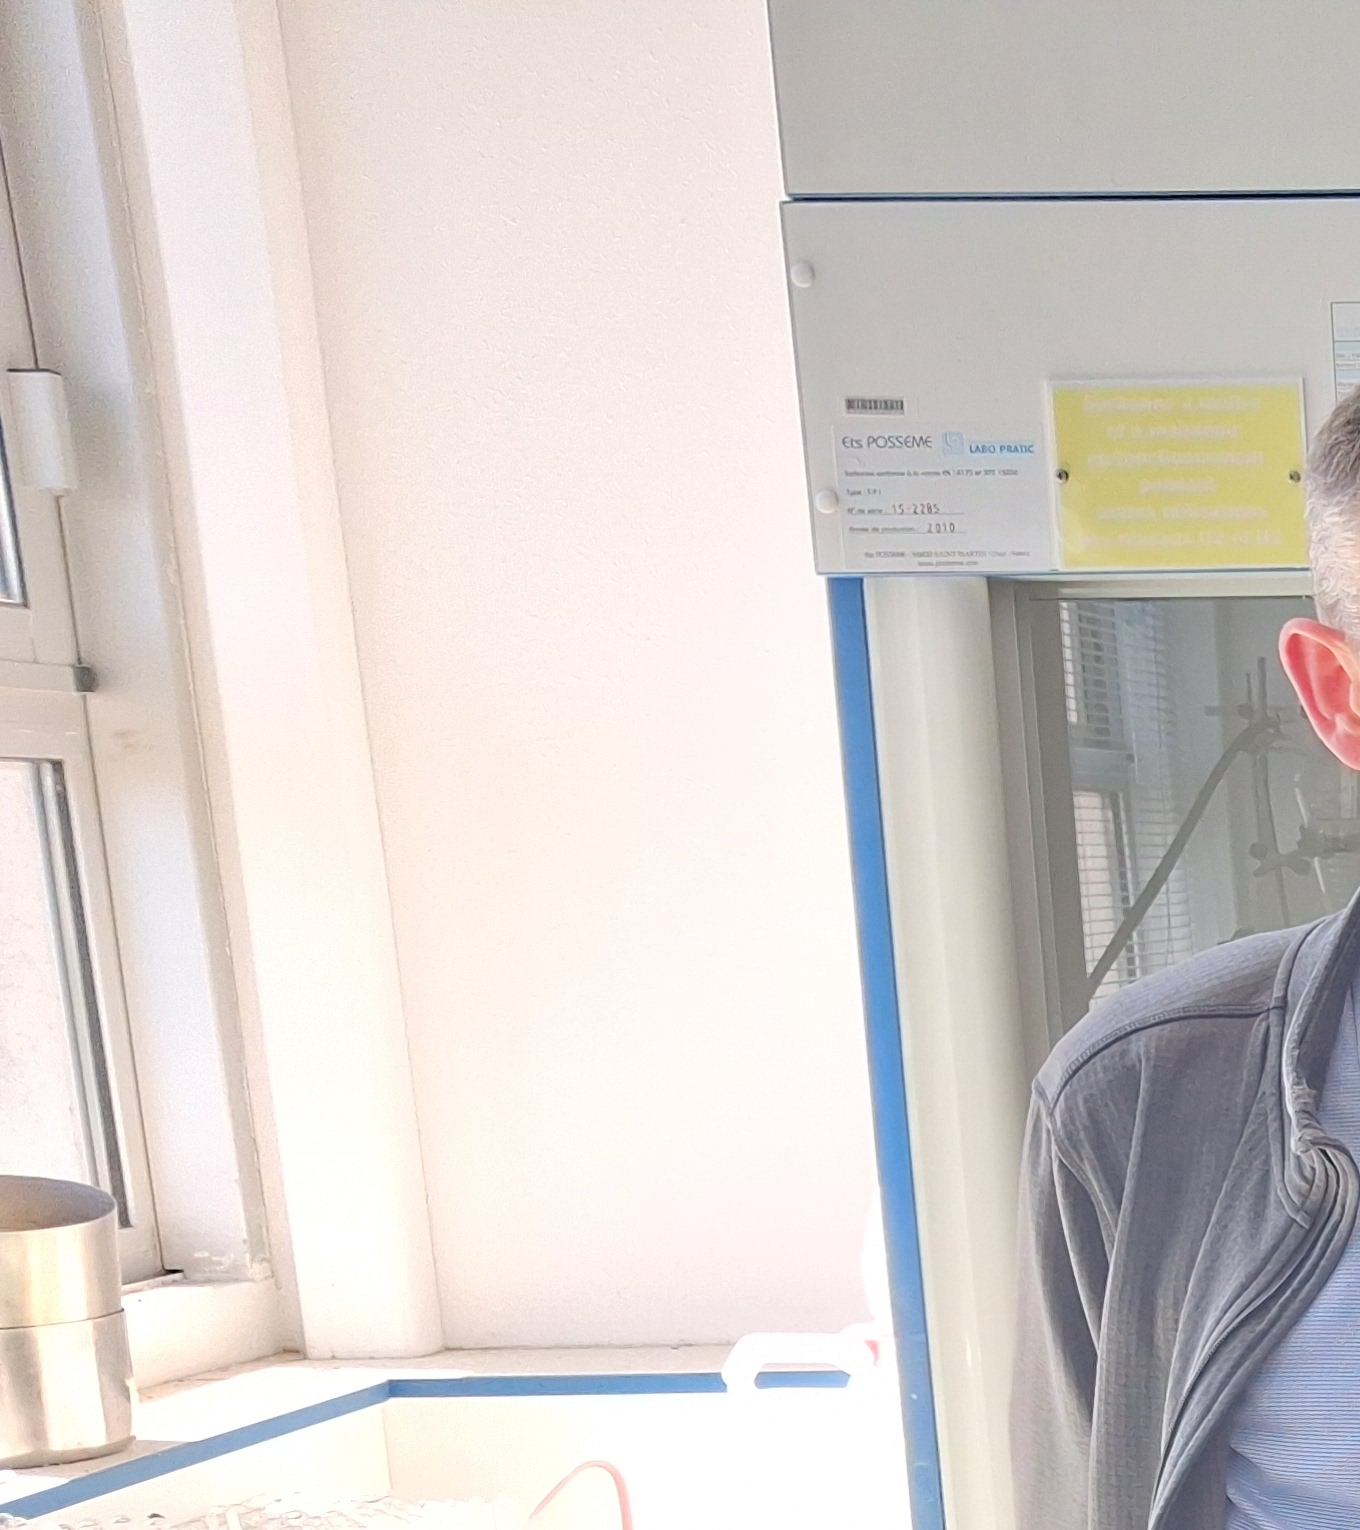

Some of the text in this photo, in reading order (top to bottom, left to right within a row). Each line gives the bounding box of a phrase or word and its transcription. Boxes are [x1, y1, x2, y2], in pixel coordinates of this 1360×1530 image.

[842, 435, 934, 450] Ets POSSEME
[969, 444, 1035, 455] LABO PRATIC
[926, 521, 956, 534] 2010
